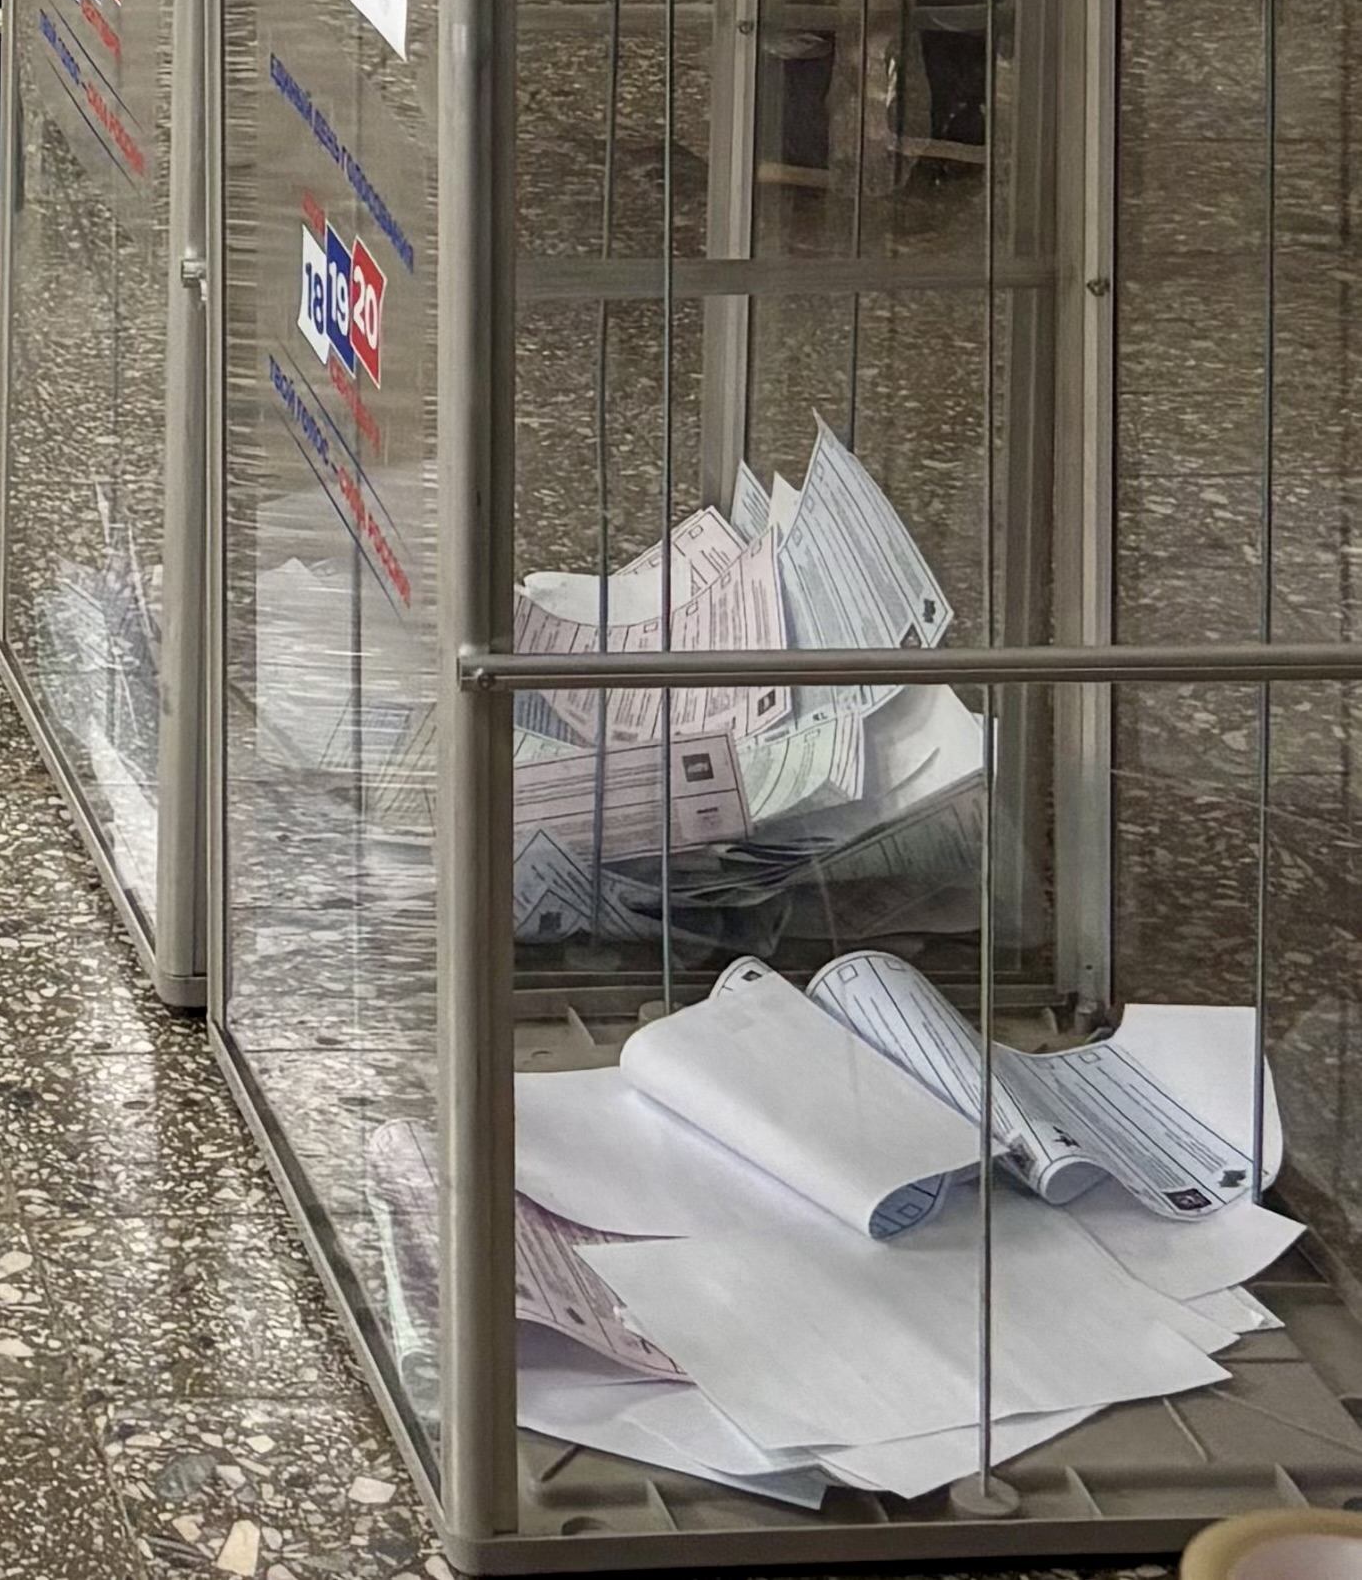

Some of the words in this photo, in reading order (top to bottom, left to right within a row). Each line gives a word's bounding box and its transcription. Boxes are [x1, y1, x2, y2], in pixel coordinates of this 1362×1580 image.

[305, 262, 324, 335] 18
[329, 261, 349, 336] 19
[353, 265, 377, 350] 20
